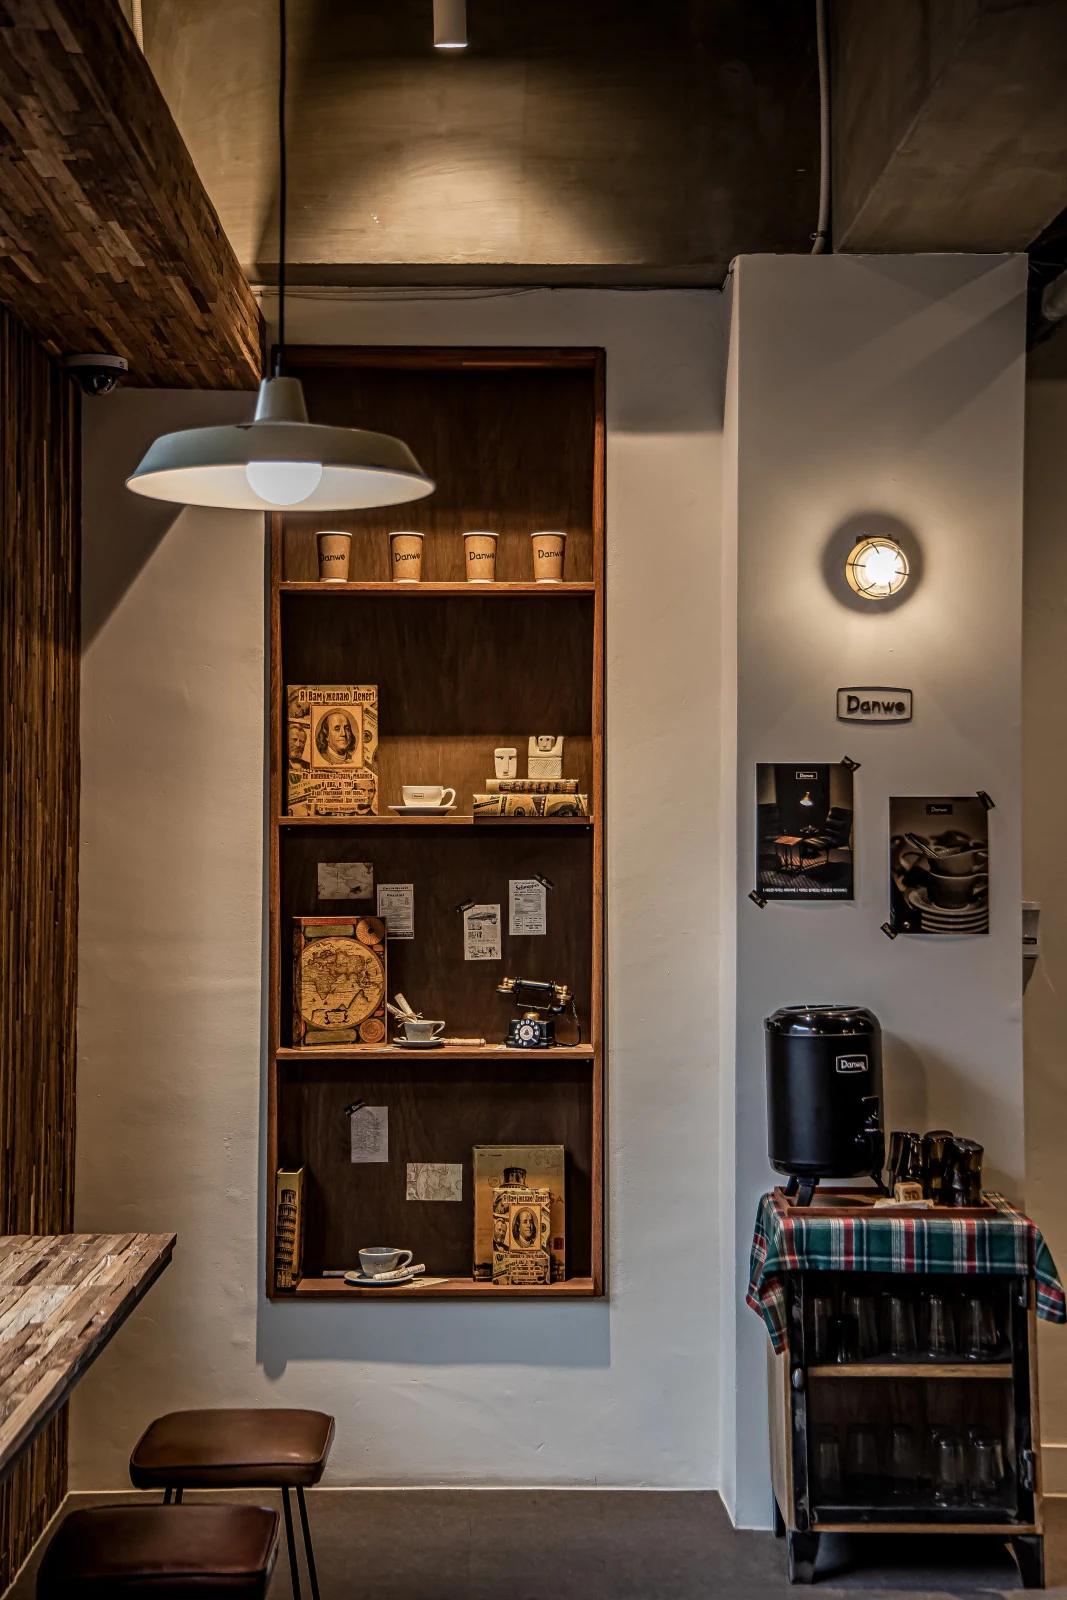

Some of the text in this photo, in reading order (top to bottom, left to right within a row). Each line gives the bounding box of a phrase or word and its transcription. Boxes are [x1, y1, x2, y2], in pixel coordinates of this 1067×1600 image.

[319, 552, 346, 563] Danwe
[394, 552, 421, 562] Danwe
[469, 551, 496, 561] Danwe
[300, 691, 375, 702] Я Вам желаю Денег!
[846, 695, 906, 714] Danwe
